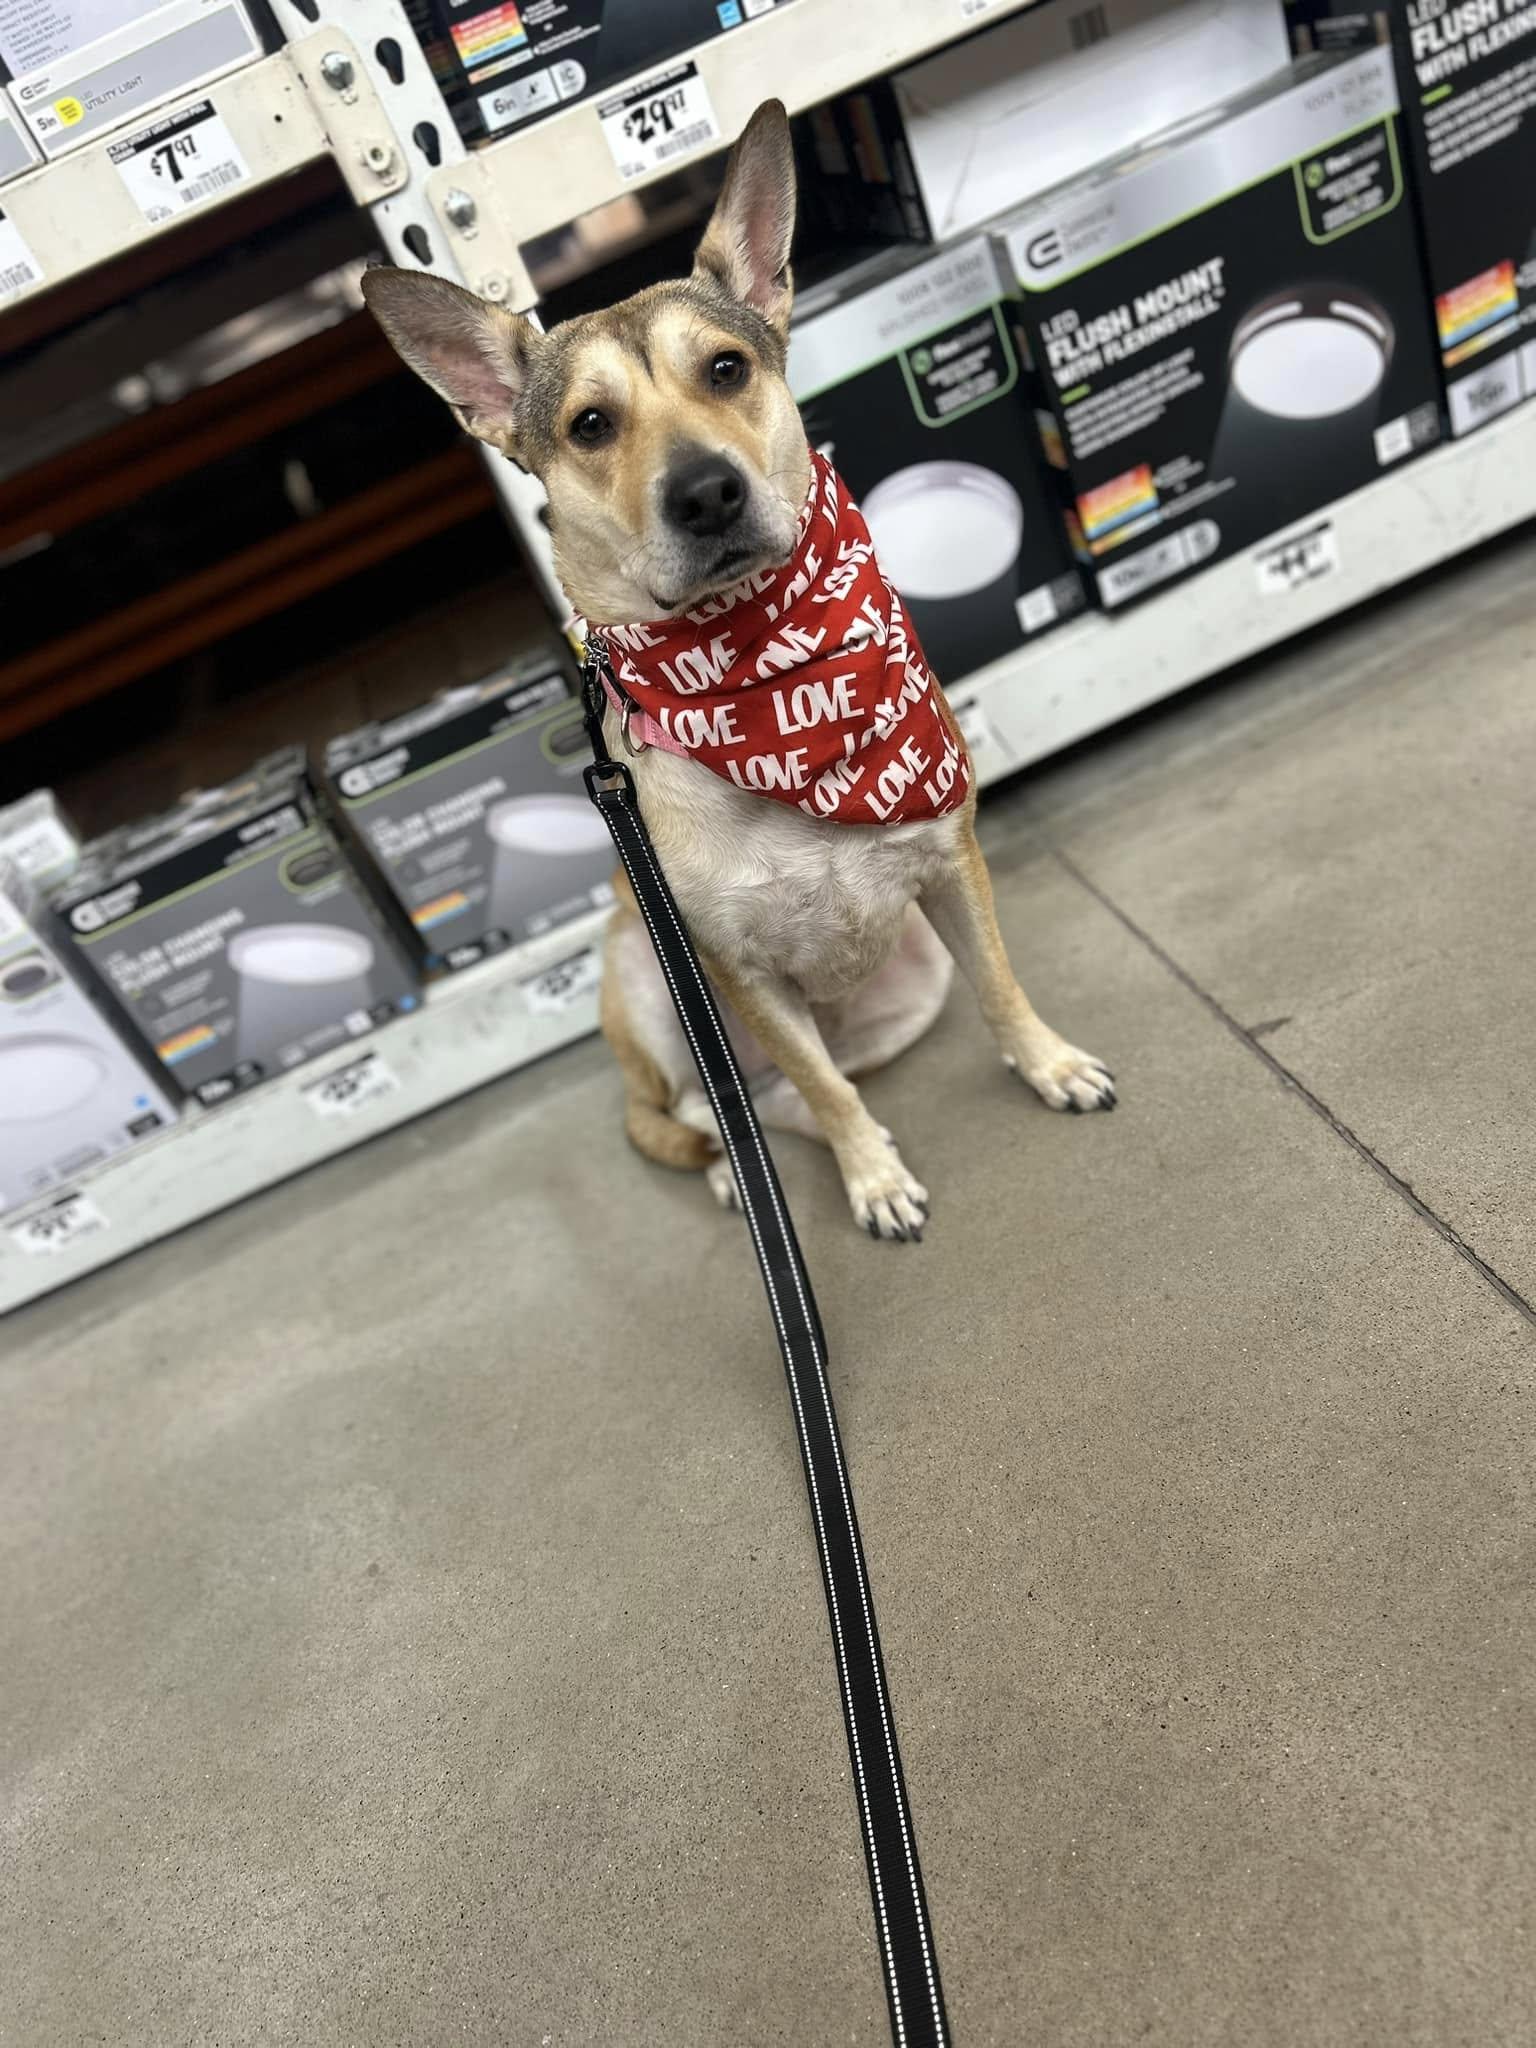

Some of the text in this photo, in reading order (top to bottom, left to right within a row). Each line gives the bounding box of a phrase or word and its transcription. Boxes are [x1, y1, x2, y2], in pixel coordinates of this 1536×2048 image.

[1411, 0, 1499, 60] FLUSH
[1415, 3, 1536, 86] WITH FLEXIN
[84, 75, 144, 110] UTILITY LIGHT
[1040, 309, 1080, 344] LED
[1047, 304, 1132, 368] FLUSH
[1133, 256, 1224, 325] MOUNT
[1053, 350, 1104, 388] WITH
[658, 631, 736, 695] LOVE
[741, 622, 827, 688] OVE
[659, 703, 747, 749] LOVE
[771, 673, 865, 736] LOVE
[726, 747, 813, 791] LOVE
[798, 756, 866, 818] LOVE
[864, 735, 931, 821] LOVE
